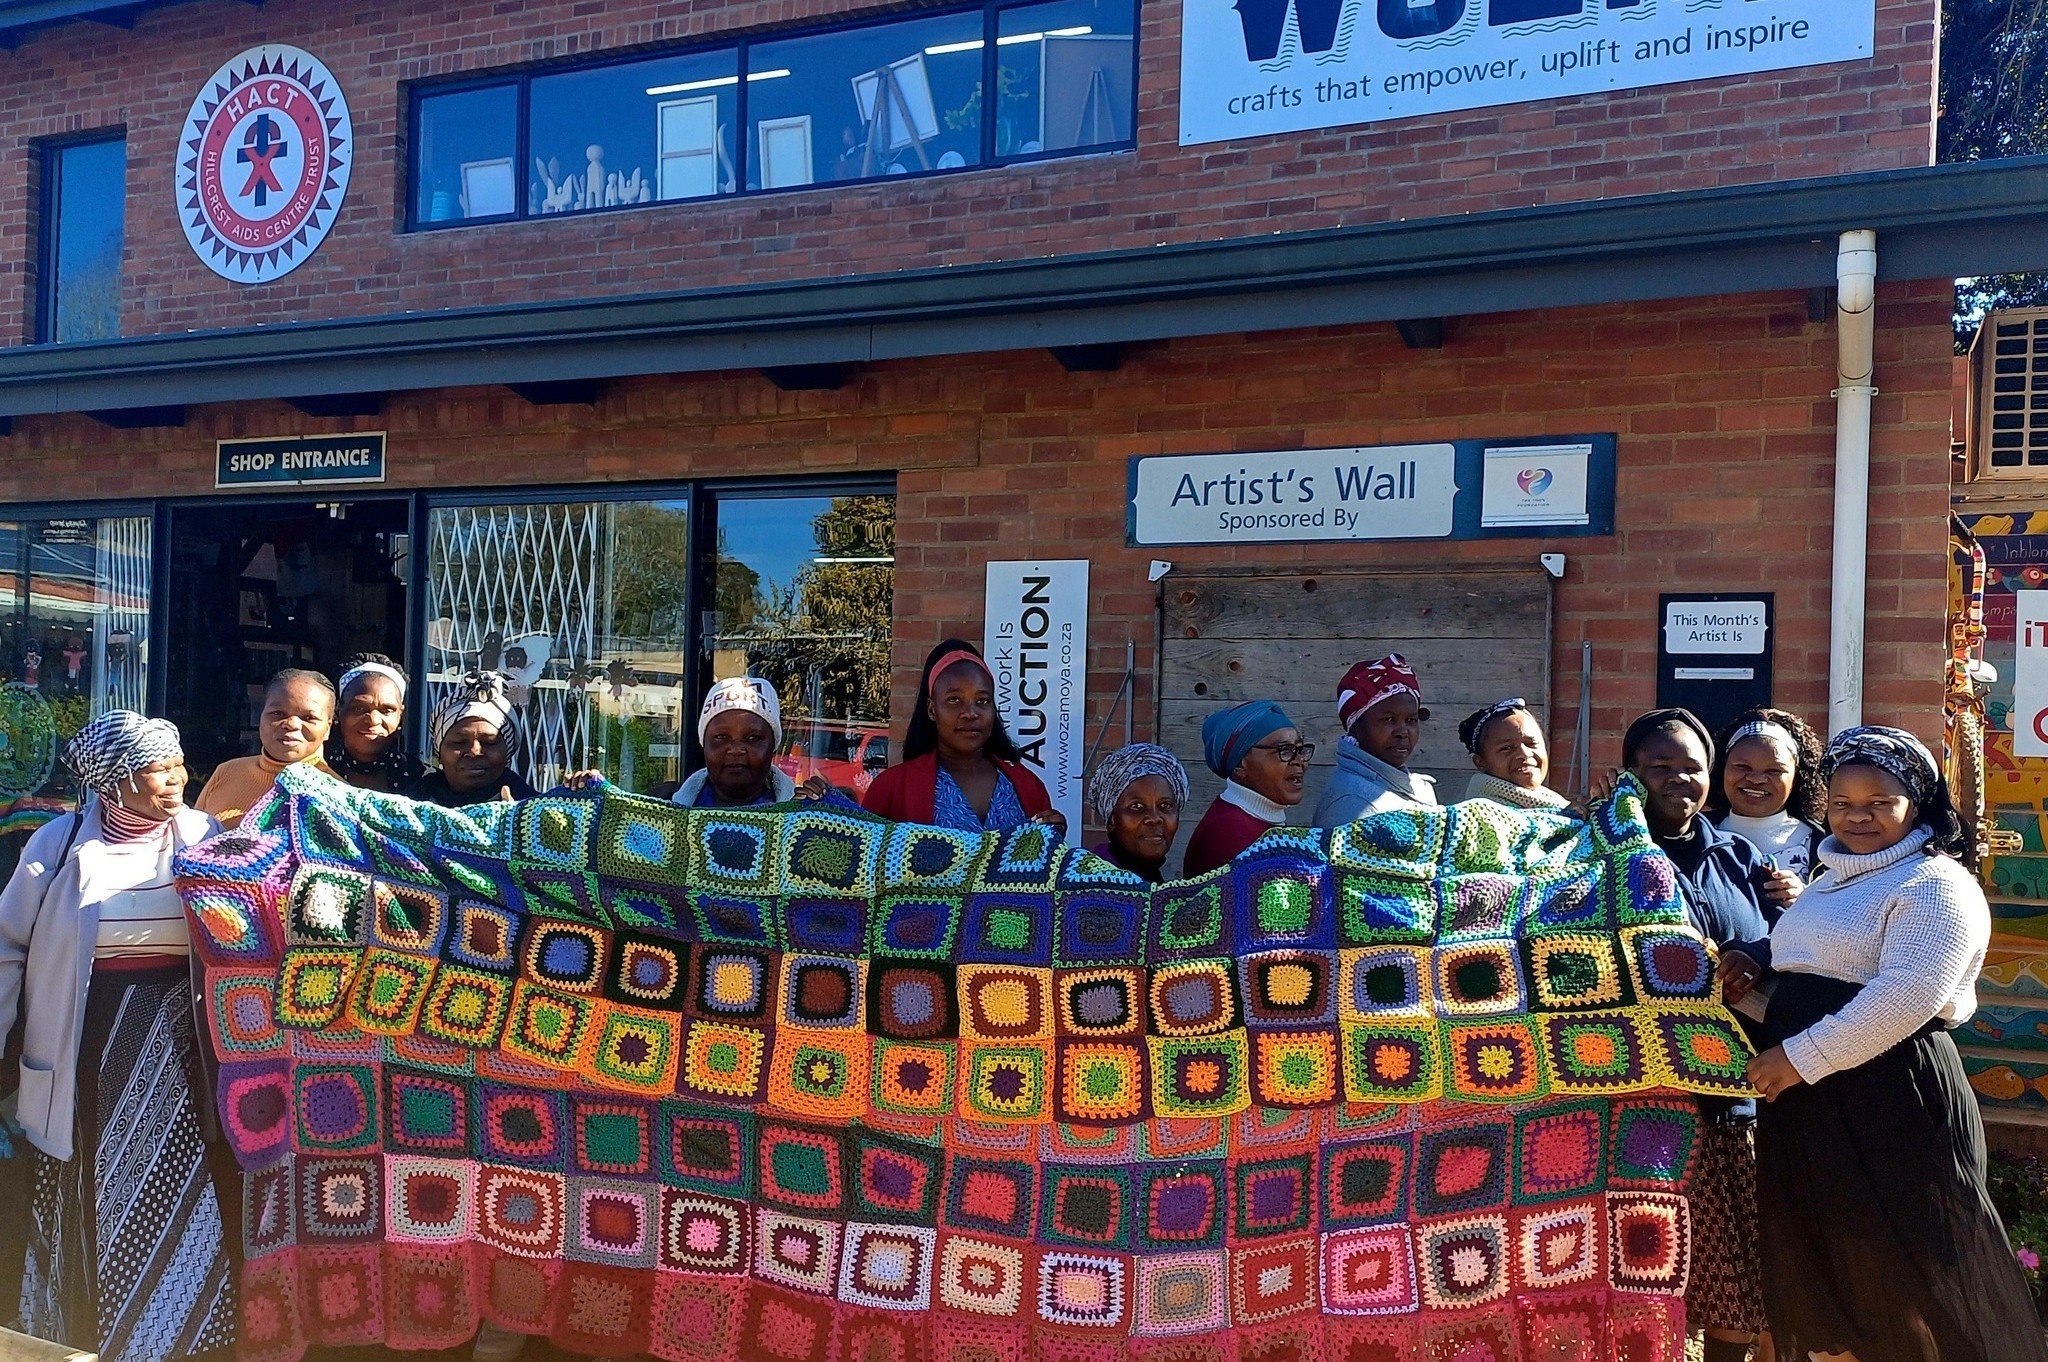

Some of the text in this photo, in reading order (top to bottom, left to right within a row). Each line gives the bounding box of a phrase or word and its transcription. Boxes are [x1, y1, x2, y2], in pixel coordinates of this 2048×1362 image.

[1228, 15, 1809, 115] crafts that empower, uplift and inspire
[226, 82, 299, 122] HACT
[205, 136, 320, 241] HILLCREST AIDS CENTRE TRUST
[230, 448, 370, 472] SHOP ENTRANCE
[1170, 461, 1417, 507] Artist's Wall
[1219, 507, 1359, 534] Sponsored By
[996, 622, 1013, 639] Is
[1673, 613, 1759, 626] This Month's
[1688, 629, 1742, 642] Artist Is
[1017, 576, 1051, 769] AUCTION
[1057, 622, 1073, 799] www.wozamoya.co.za
